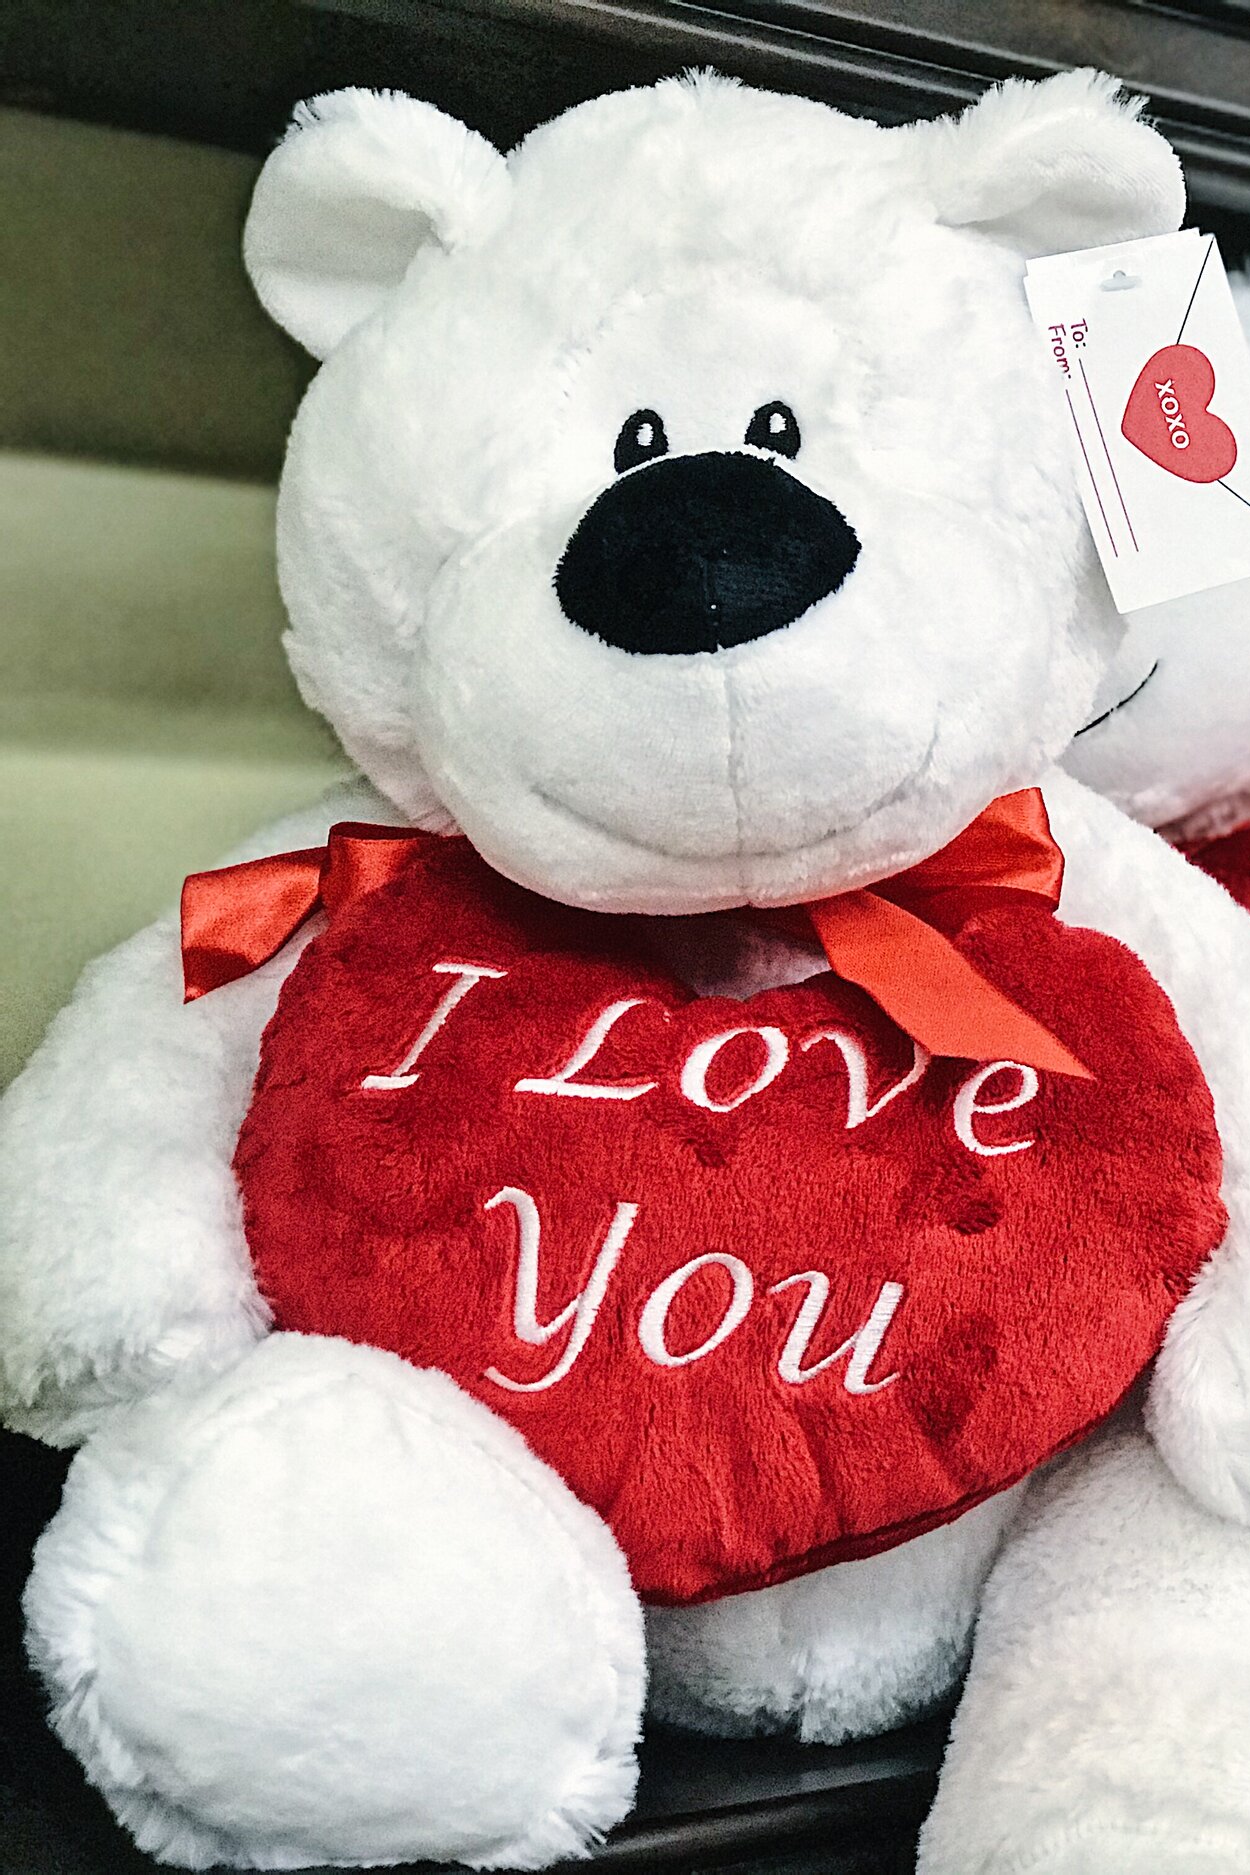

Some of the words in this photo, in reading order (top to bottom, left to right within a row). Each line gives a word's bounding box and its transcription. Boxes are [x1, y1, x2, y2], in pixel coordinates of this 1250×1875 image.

[1070, 317, 1088, 349] To:
[359, 962, 509, 1091] I
[514, 999, 1040, 1157] Love
[483, 1186, 903, 1396] You
